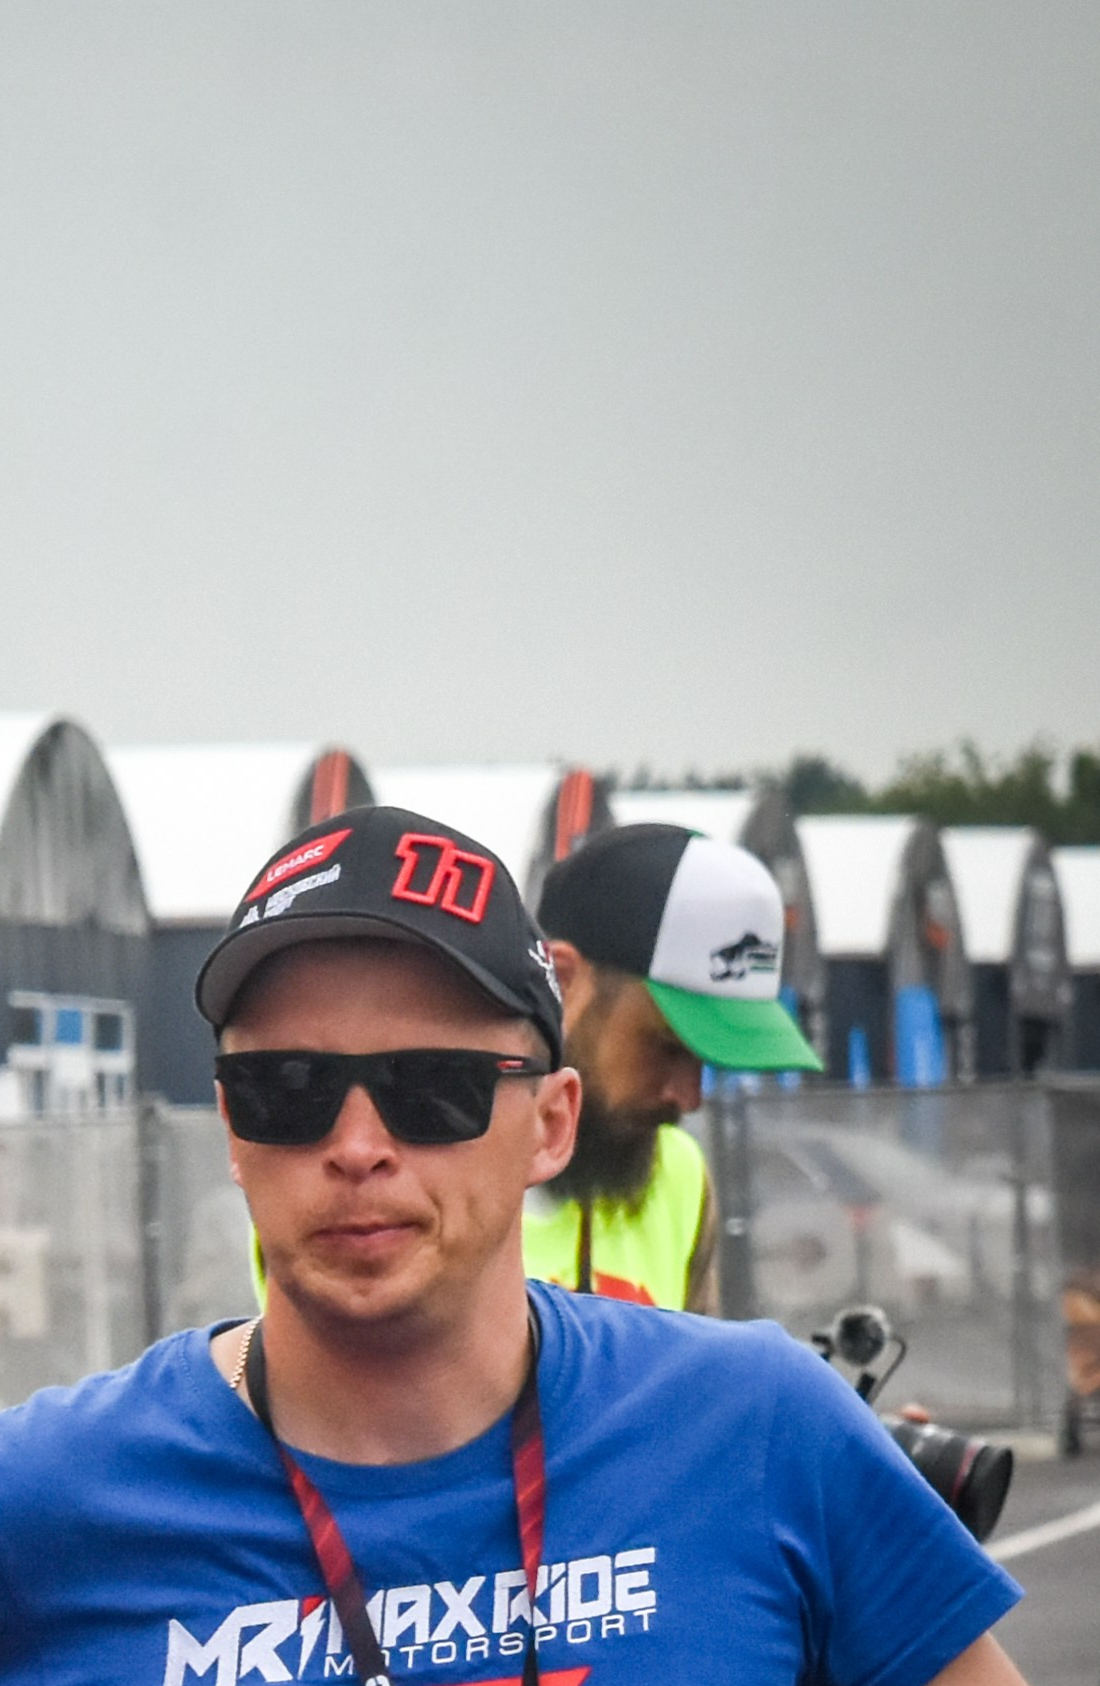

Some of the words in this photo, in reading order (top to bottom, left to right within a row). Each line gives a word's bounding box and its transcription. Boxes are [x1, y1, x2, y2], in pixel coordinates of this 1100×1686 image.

[266, 845, 325, 882] LEMARC
[492, 1547, 657, 1634] RIDE
[323, 1608, 657, 1679] MTORSPORT
